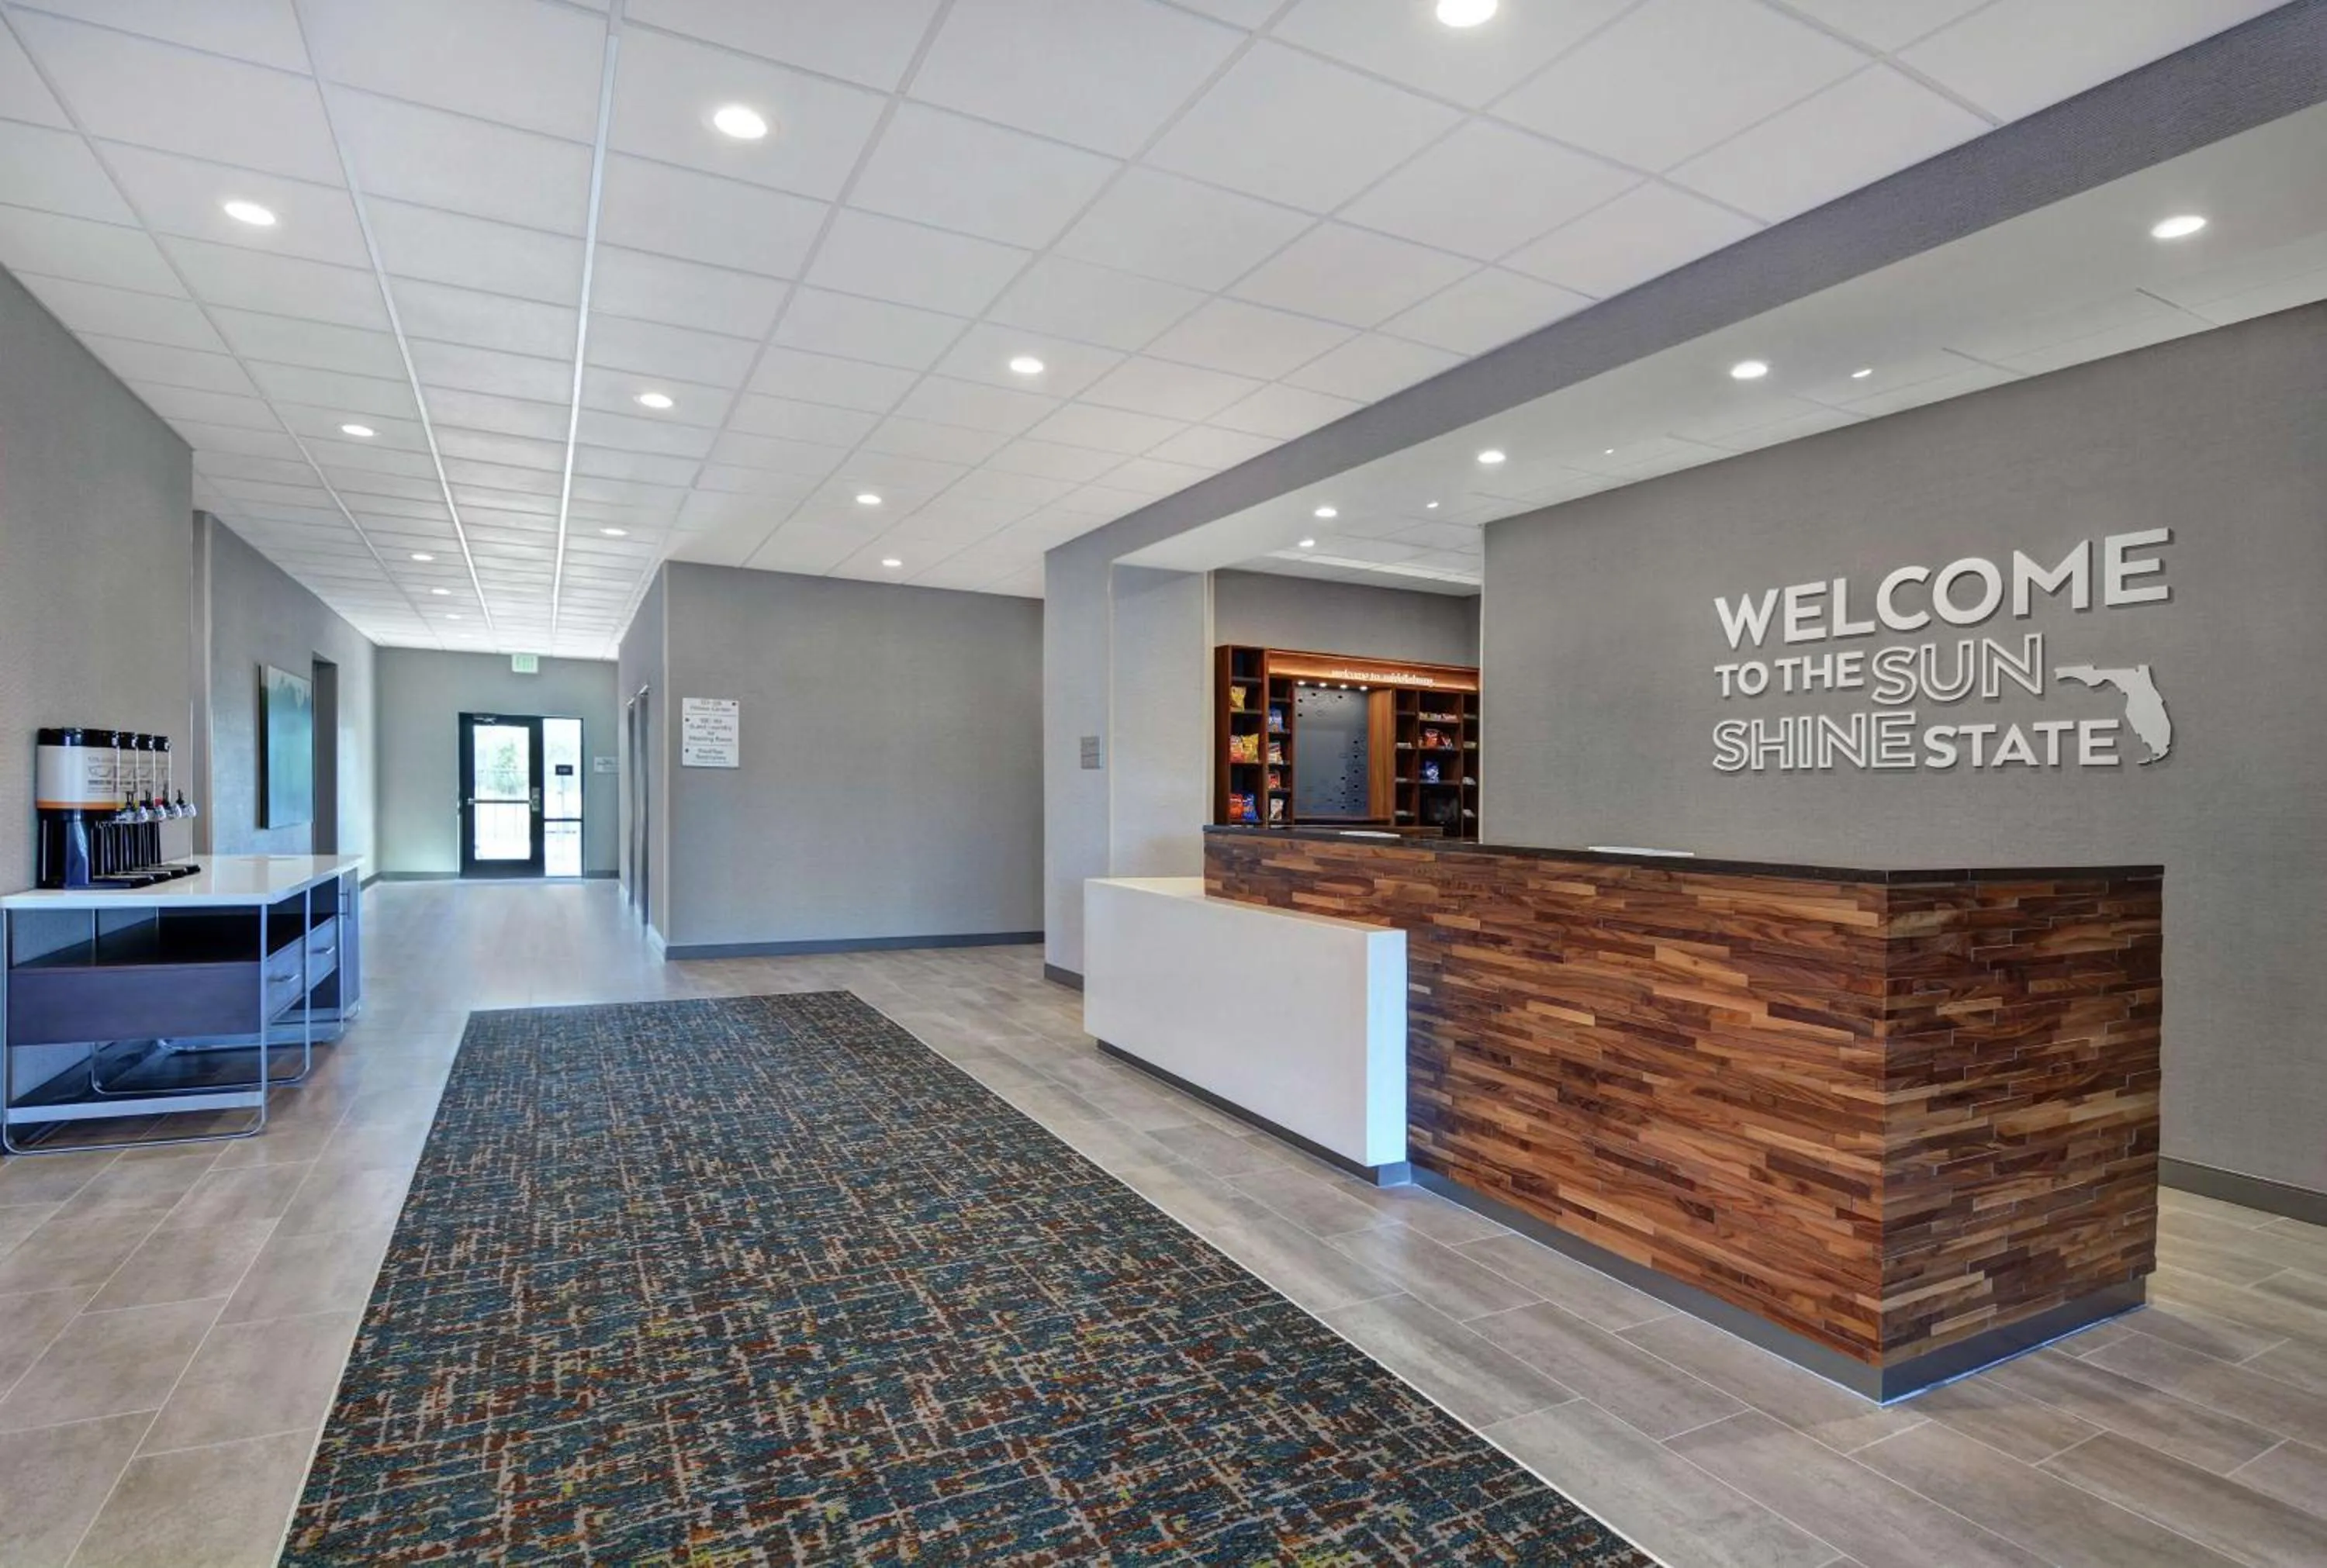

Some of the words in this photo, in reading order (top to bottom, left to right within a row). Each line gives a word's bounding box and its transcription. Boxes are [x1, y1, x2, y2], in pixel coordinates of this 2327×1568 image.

[1713, 527, 2170, 649] WELCOME
[1713, 661, 1769, 697] TO
[1775, 651, 1865, 692] THE
[1872, 633, 2044, 705] SUN
[1712, 711, 1917, 772] SHINE
[1924, 719, 2120, 768] STATE
